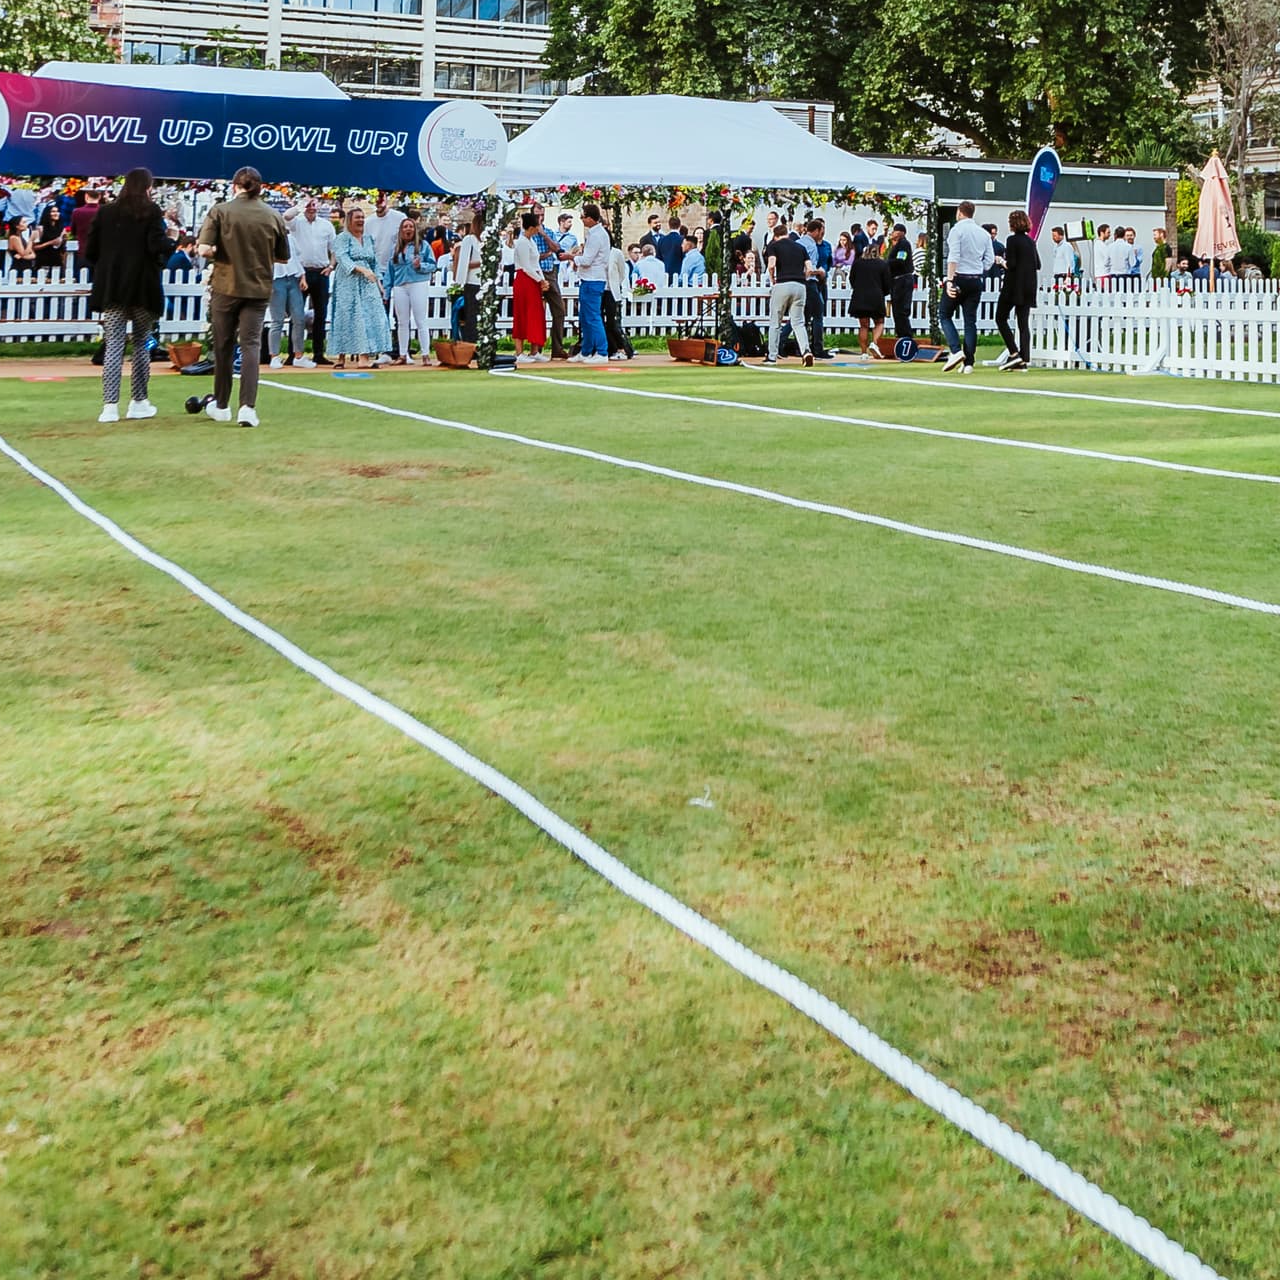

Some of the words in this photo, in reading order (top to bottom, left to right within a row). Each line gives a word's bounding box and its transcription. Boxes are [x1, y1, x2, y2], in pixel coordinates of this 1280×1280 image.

[21, 111, 148, 144] BOWL
[159, 119, 214, 146] UP
[223, 122, 337, 153] BOWL
[347, 129, 409, 157] UP!
[441, 127, 465, 138] THE
[440, 137, 497, 151] BOWLS
[440, 149, 481, 162] CLUB
[902, 340, 912, 356] 1
